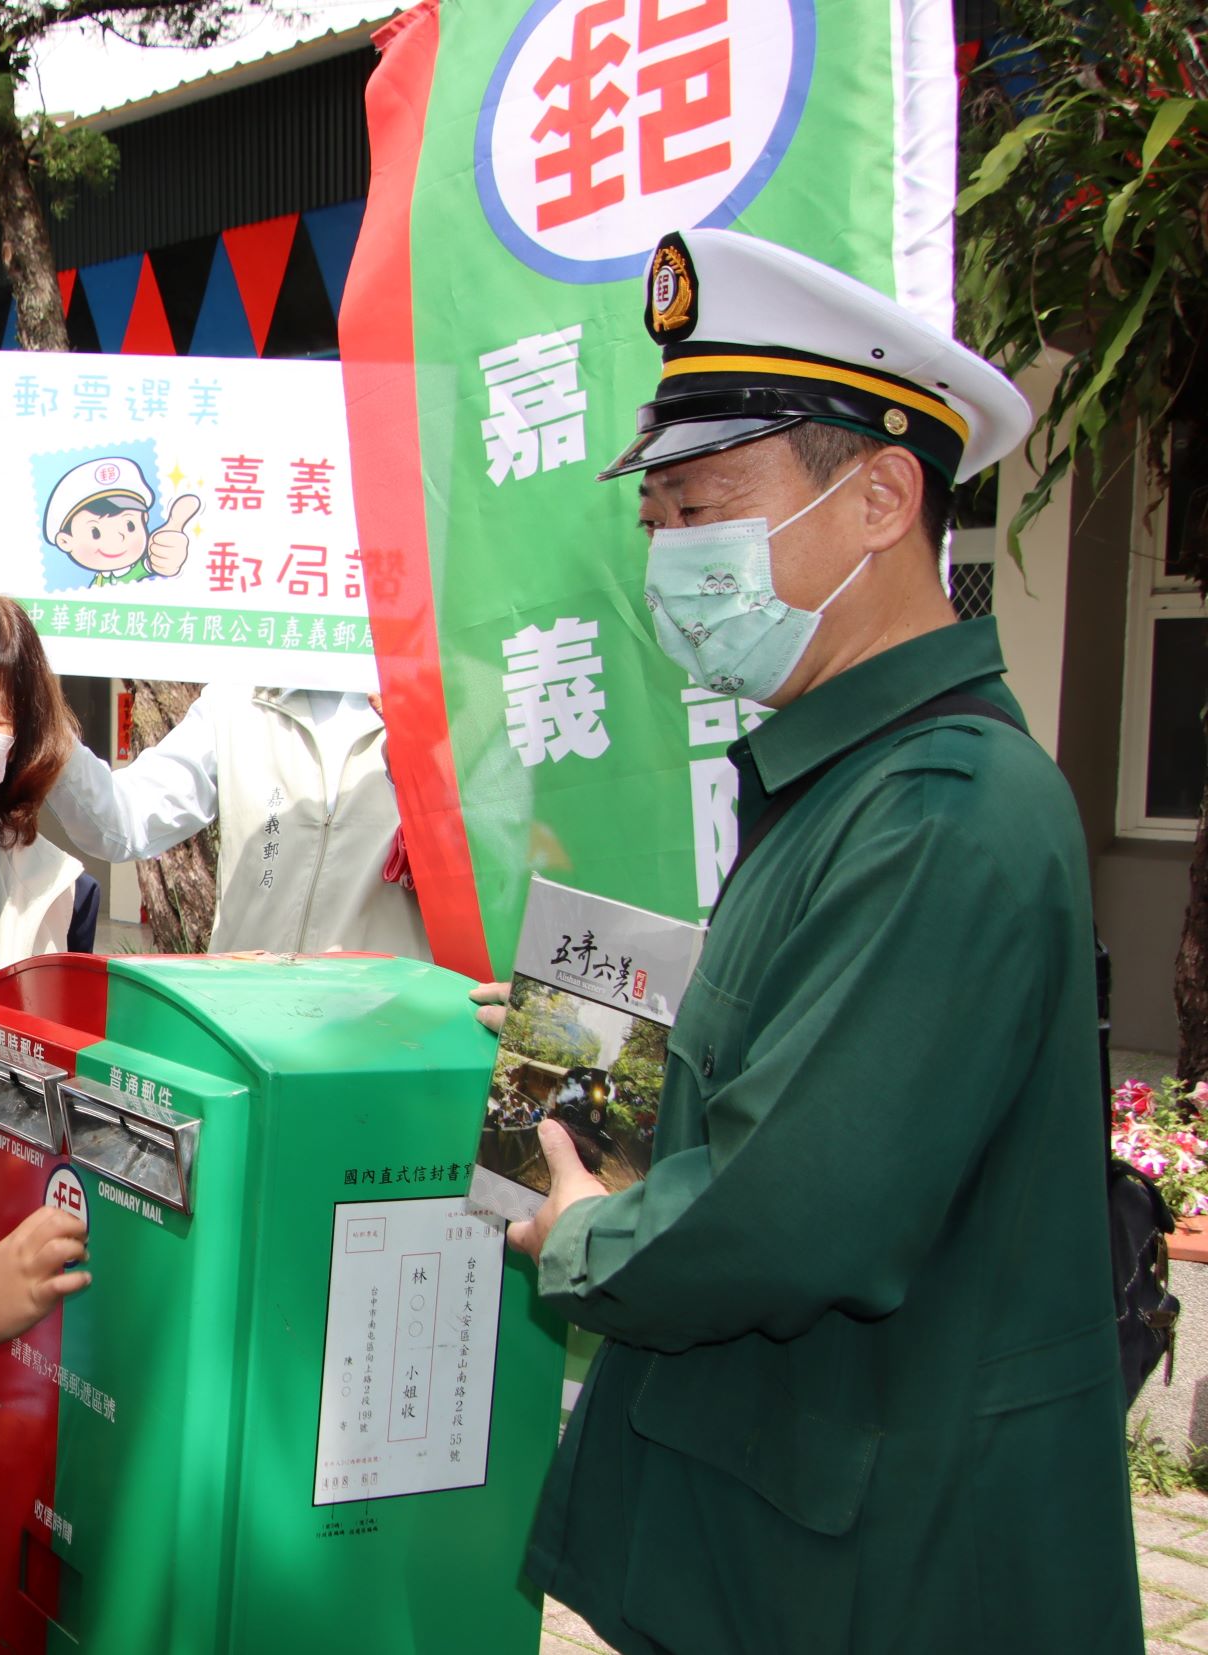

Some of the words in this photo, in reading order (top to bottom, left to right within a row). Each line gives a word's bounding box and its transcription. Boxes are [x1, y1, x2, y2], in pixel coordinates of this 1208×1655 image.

[12, 374, 223, 425] 郵票選美
[214, 454, 335, 516] 嘉義
[479, 322, 611, 767] 嘉義
[259, 787, 284, 888] 嘉義郵局
[109, 1065, 173, 1109] 普通郵件
[11, 1135, 45, 1169] DELIVERY
[98, 1181, 141, 1211] ORDINARY
[142, 1202, 164, 1225] MAIL
[34, 1499, 73, 1545] 收信時間
